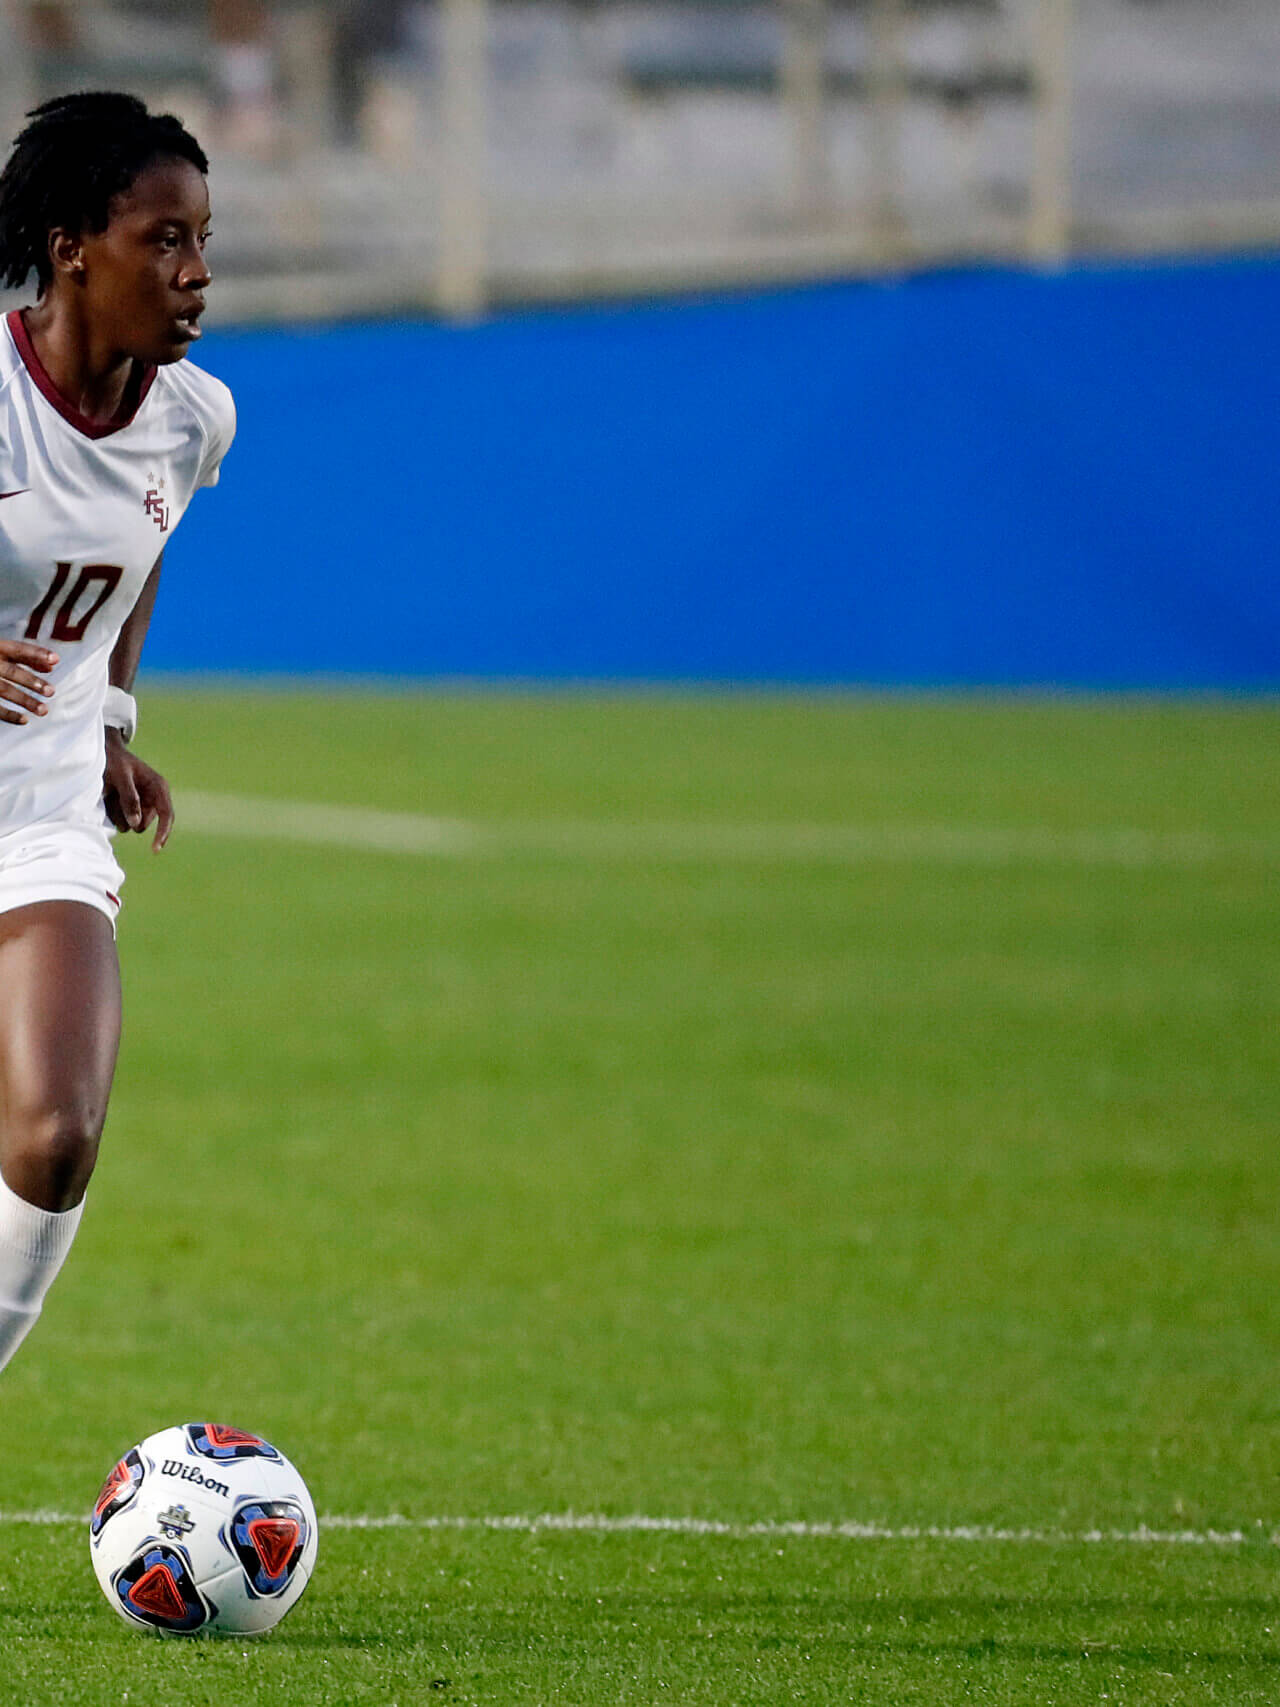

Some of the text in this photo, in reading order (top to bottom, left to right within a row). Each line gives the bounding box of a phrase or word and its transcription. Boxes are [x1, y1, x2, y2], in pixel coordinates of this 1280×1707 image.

[144, 489, 170, 532] FSU
[24, 562, 124, 642] 10
[161, 1459, 230, 1499] Wilson
